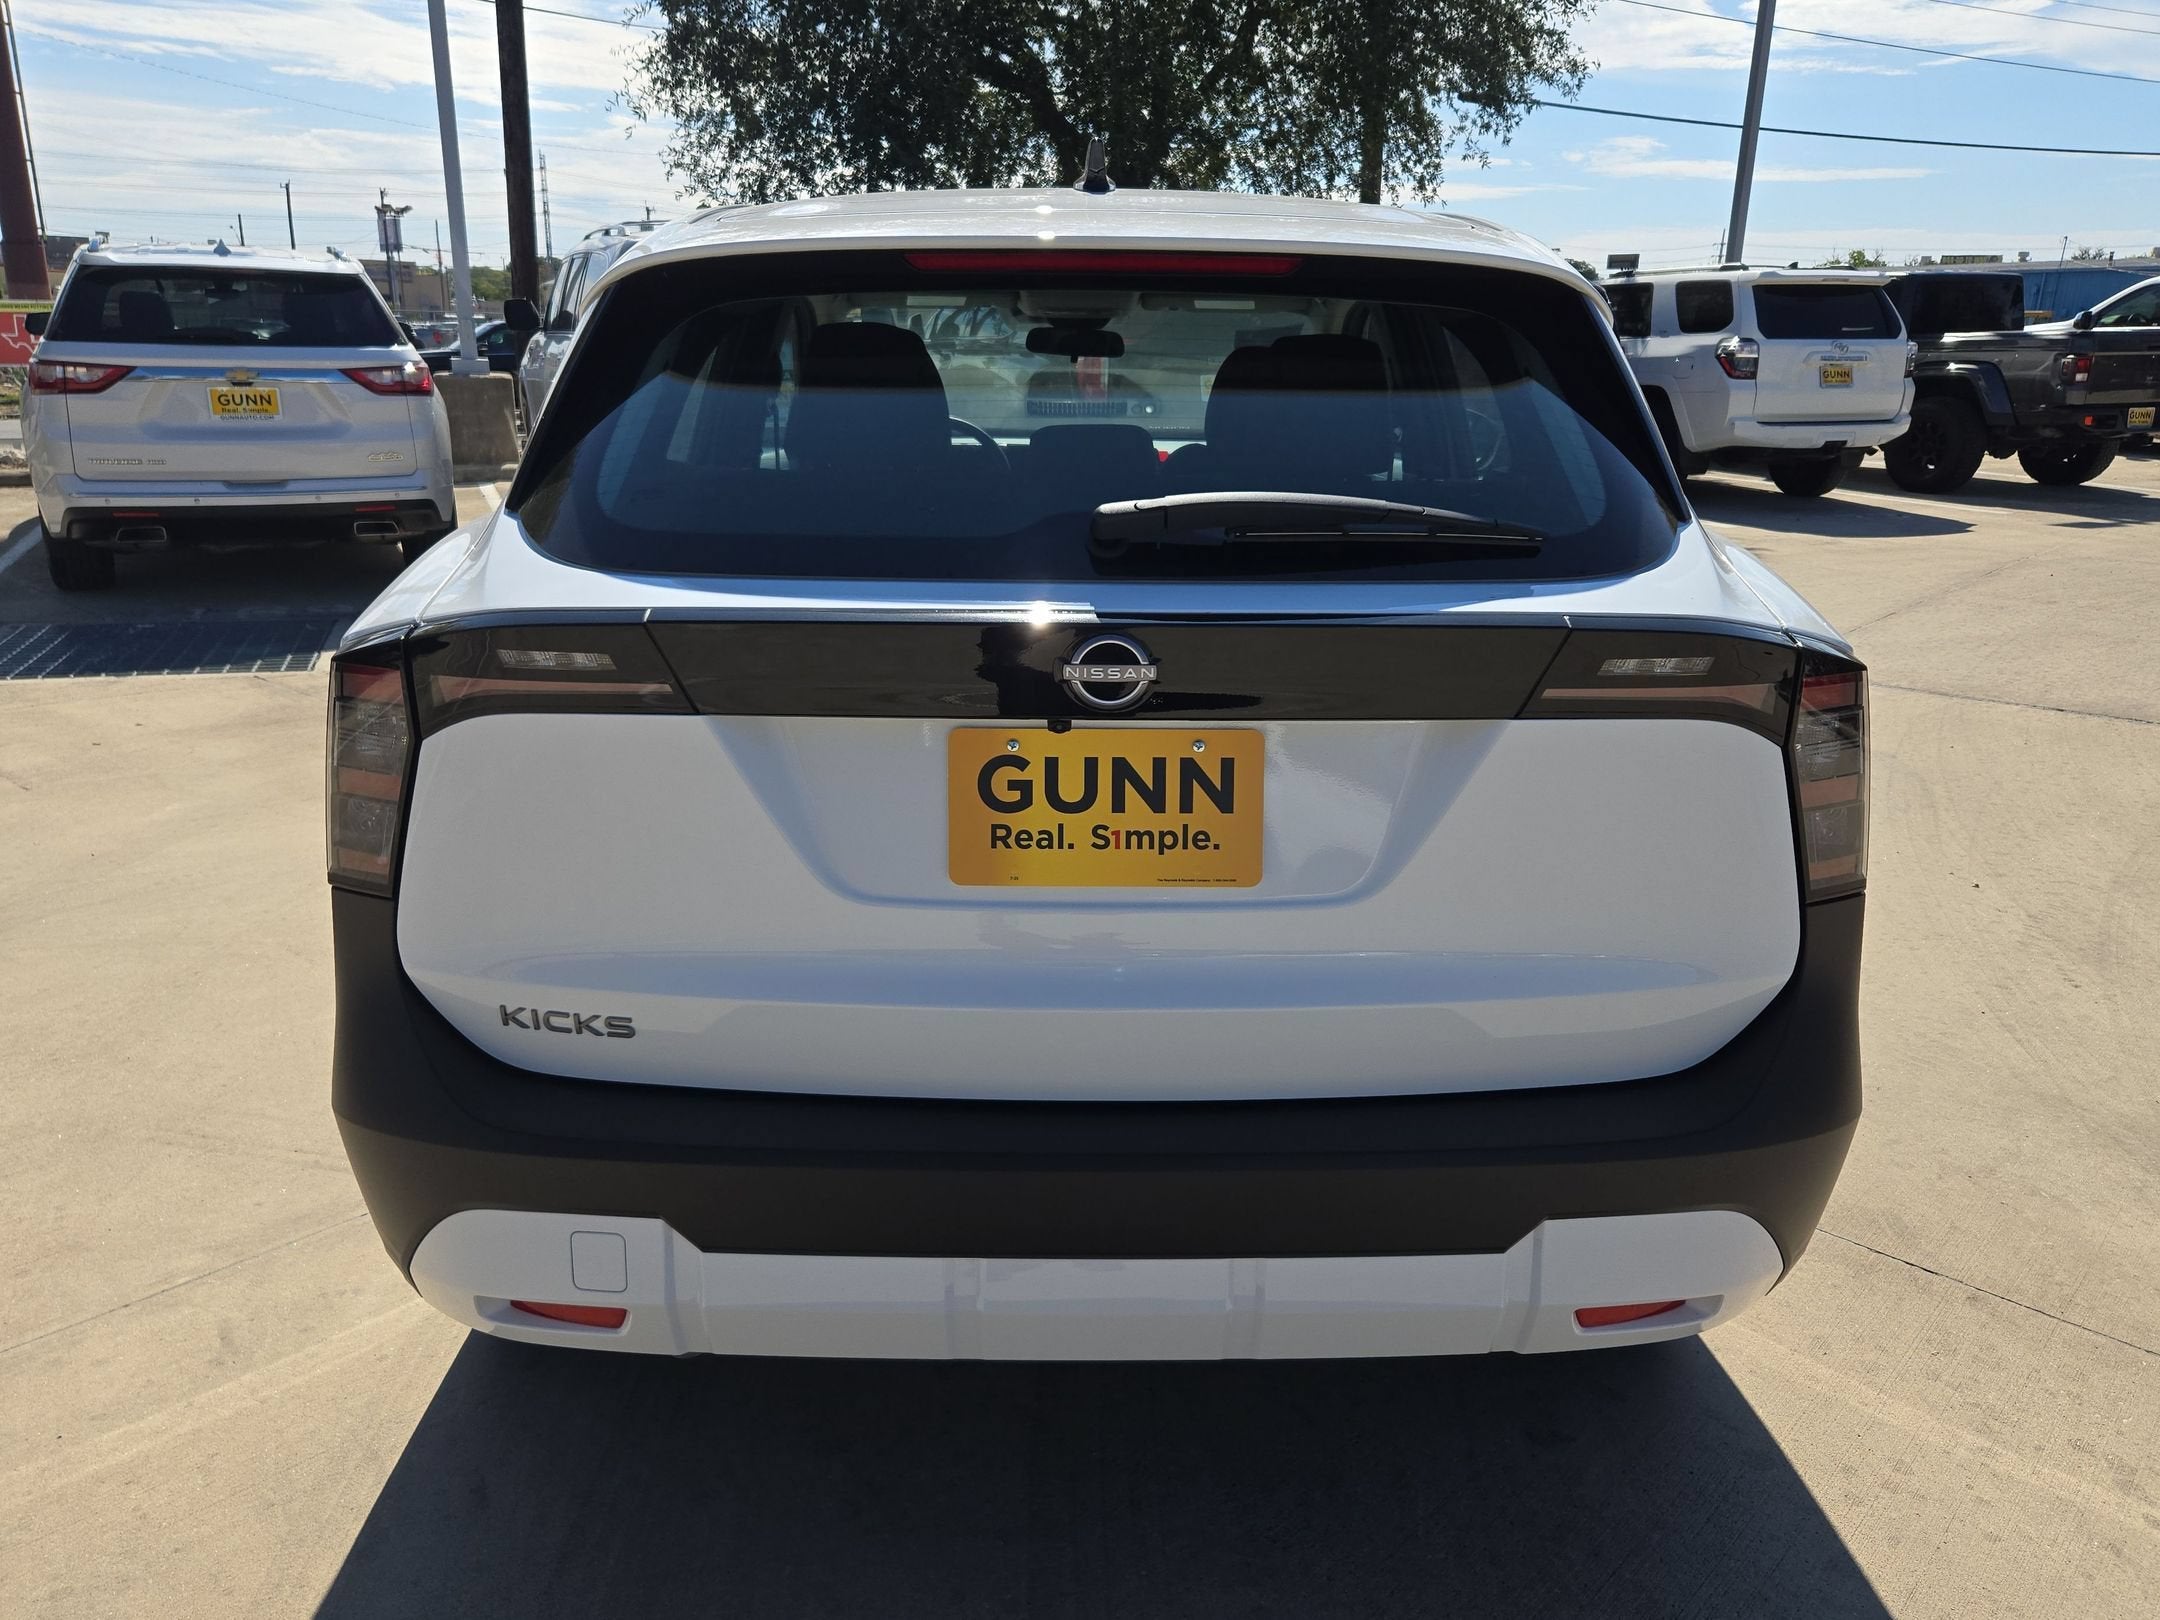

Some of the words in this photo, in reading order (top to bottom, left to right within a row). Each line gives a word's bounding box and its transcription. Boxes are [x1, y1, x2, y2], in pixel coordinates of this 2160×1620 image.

[1822, 369, 1850, 379] GUNN
[217, 393, 273, 406] GUNN
[2129, 410, 2152, 420] GUNN
[1064, 666, 1155, 679] NISSAN
[977, 754, 1235, 815] GUNN
[990, 823, 1075, 850] Real.
[499, 1004, 636, 1039] KICKS
